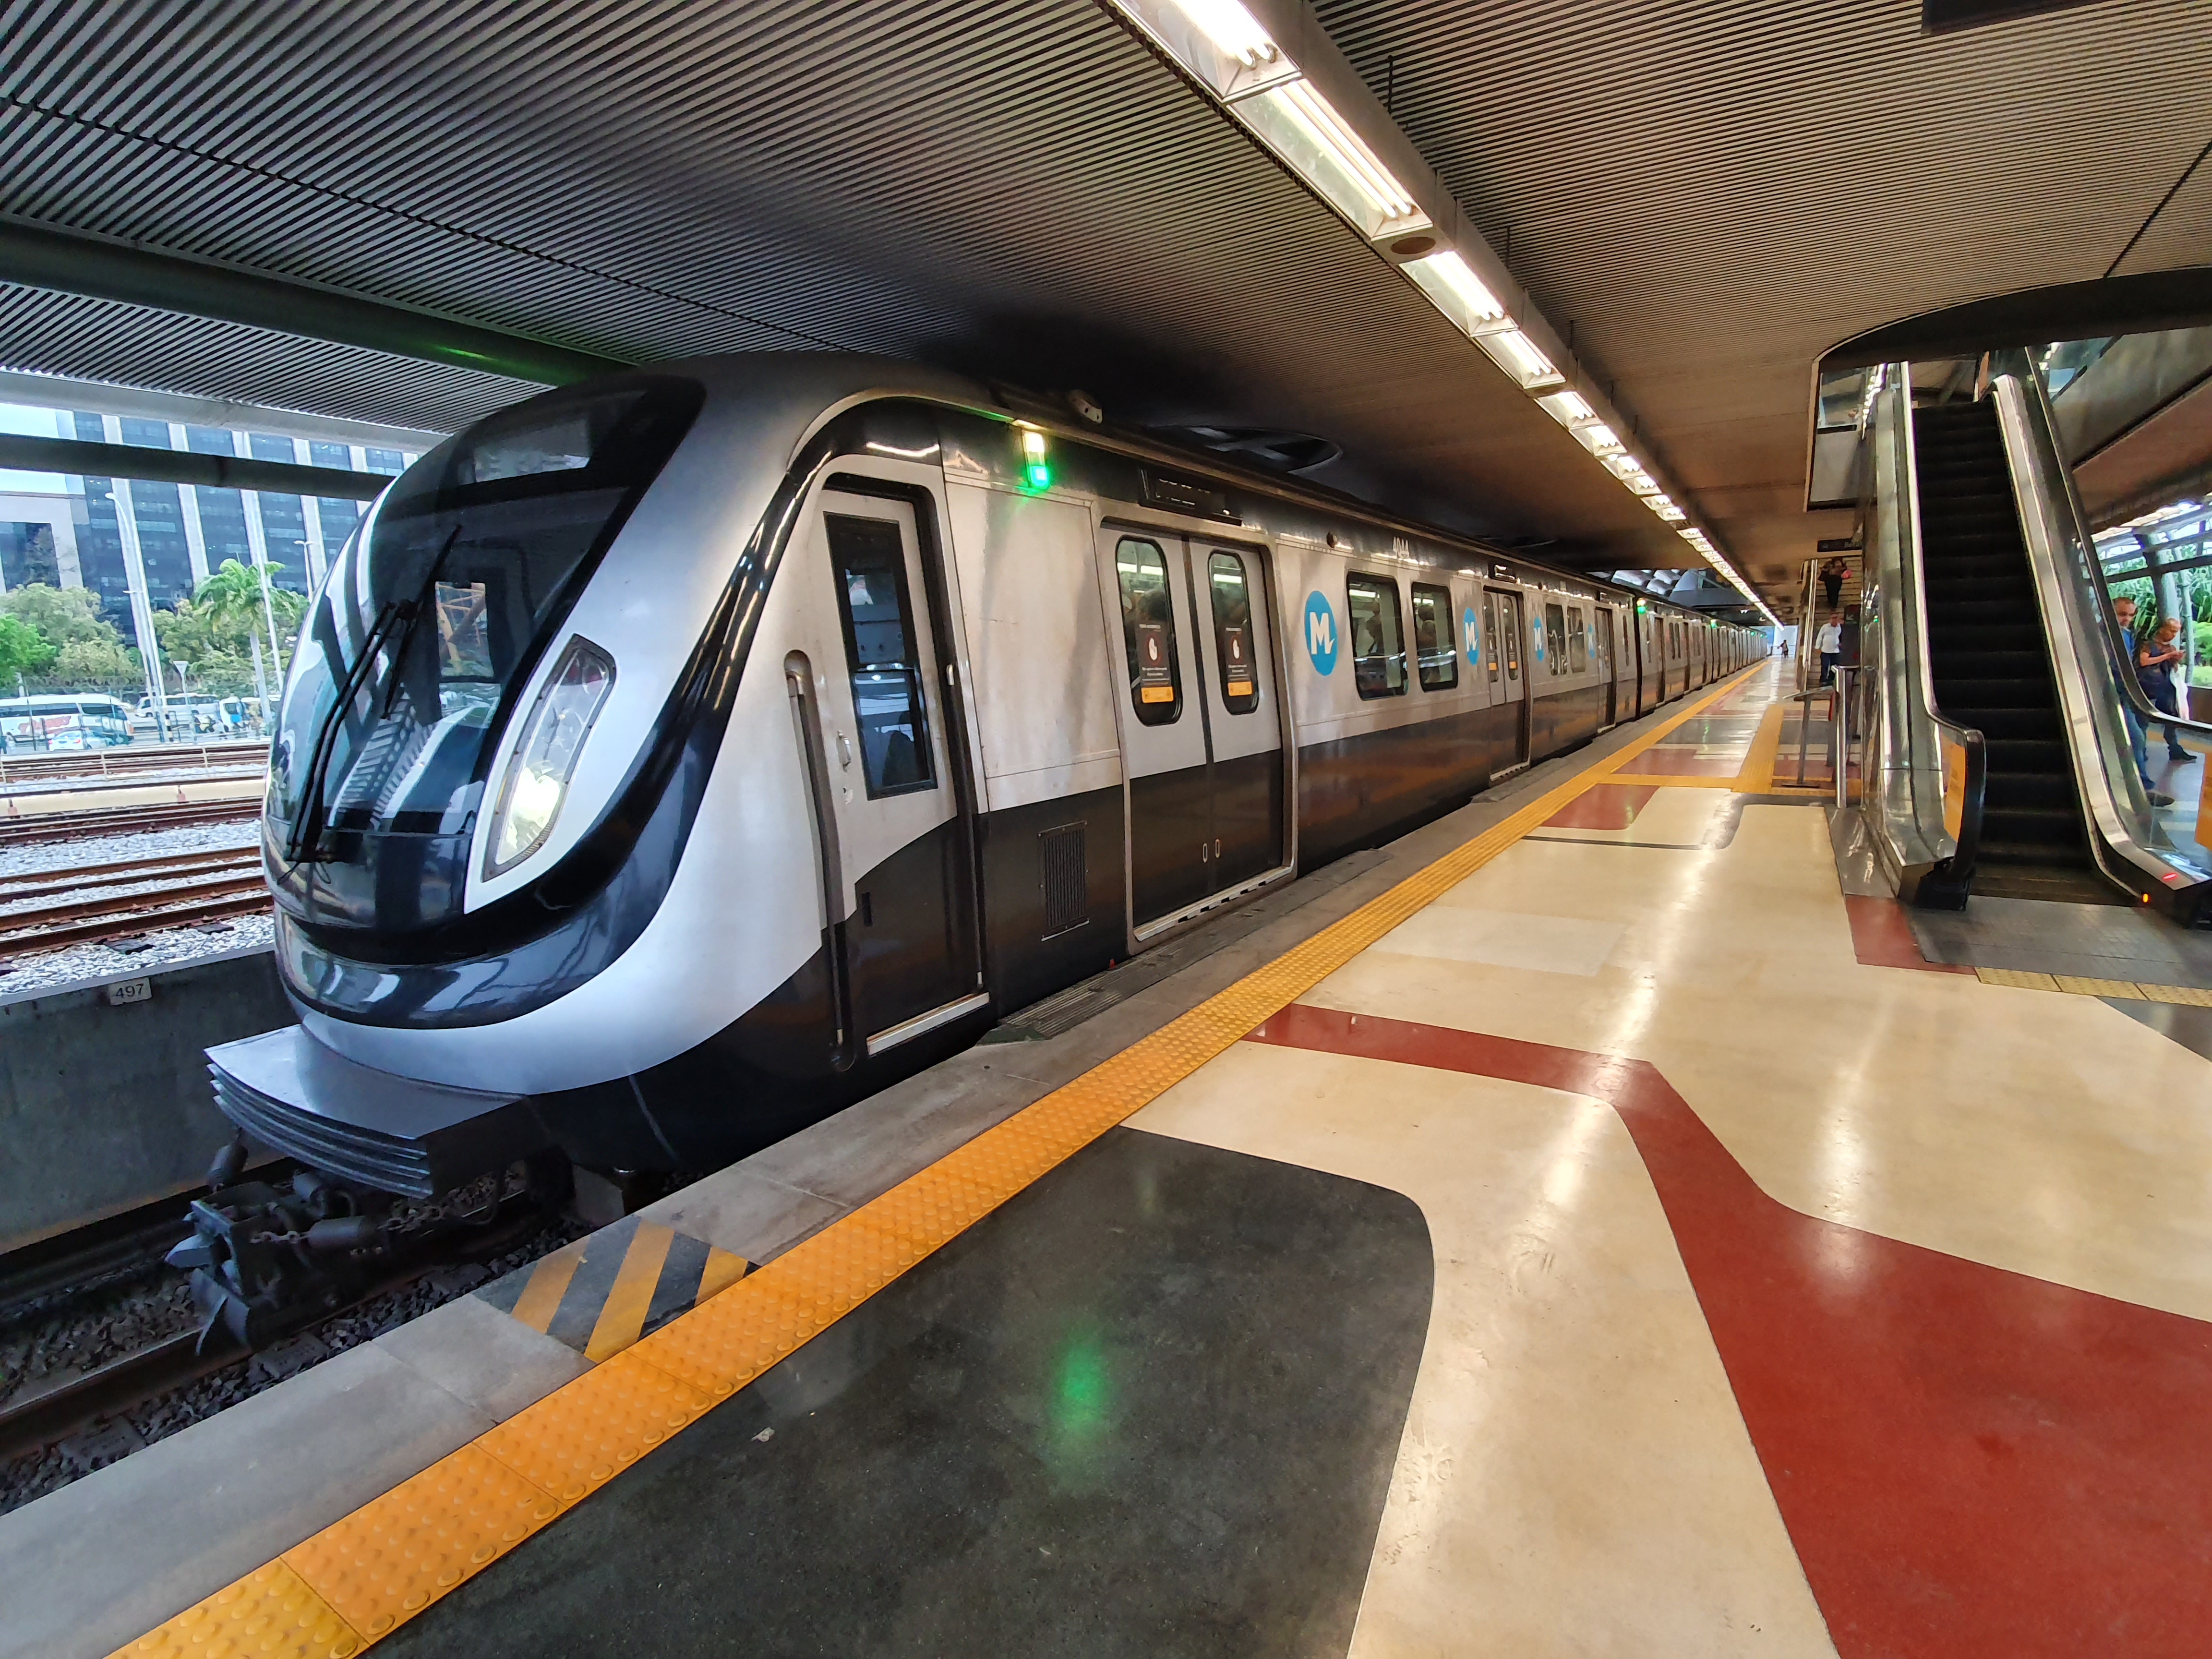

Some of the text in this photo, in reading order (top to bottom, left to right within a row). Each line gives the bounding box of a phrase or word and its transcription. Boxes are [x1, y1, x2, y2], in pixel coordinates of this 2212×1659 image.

[1310, 612, 1335, 655] M
[1465, 621, 1478, 652] M
[116, 983, 144, 998] 497
